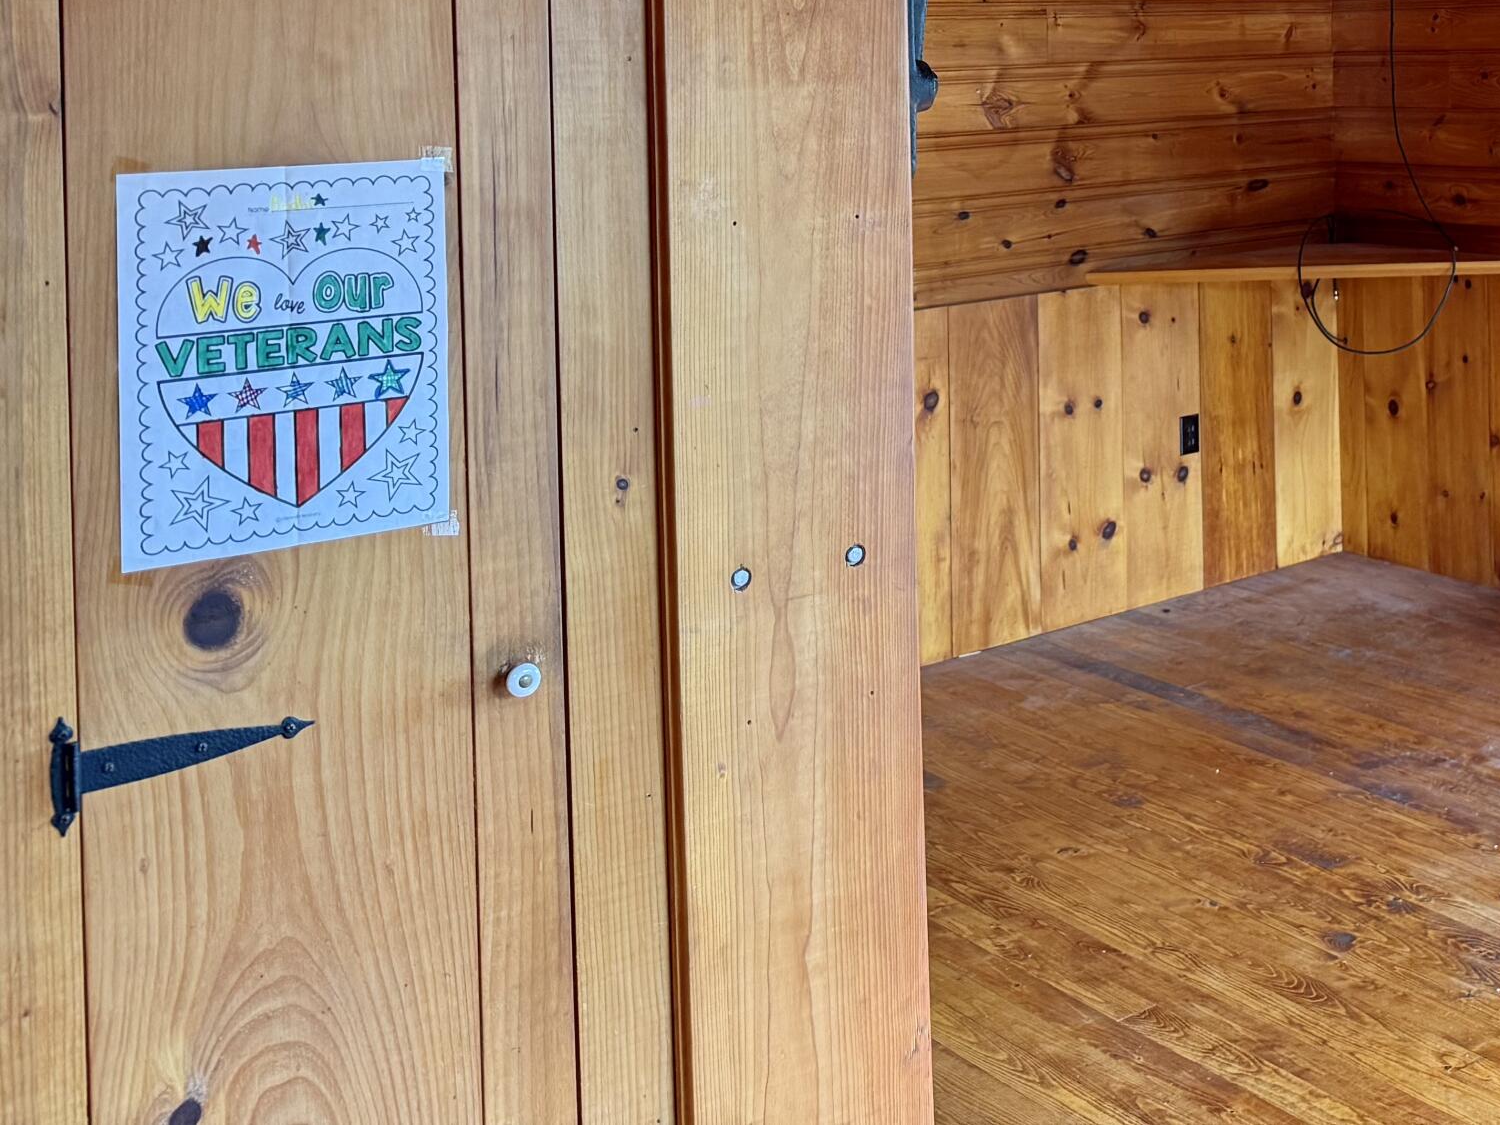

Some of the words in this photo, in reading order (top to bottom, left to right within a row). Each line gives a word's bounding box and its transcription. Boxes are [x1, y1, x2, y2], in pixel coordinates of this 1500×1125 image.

[186, 276, 262, 323] We
[274, 293, 306, 314] love
[155, 317, 423, 377] VETERANS
